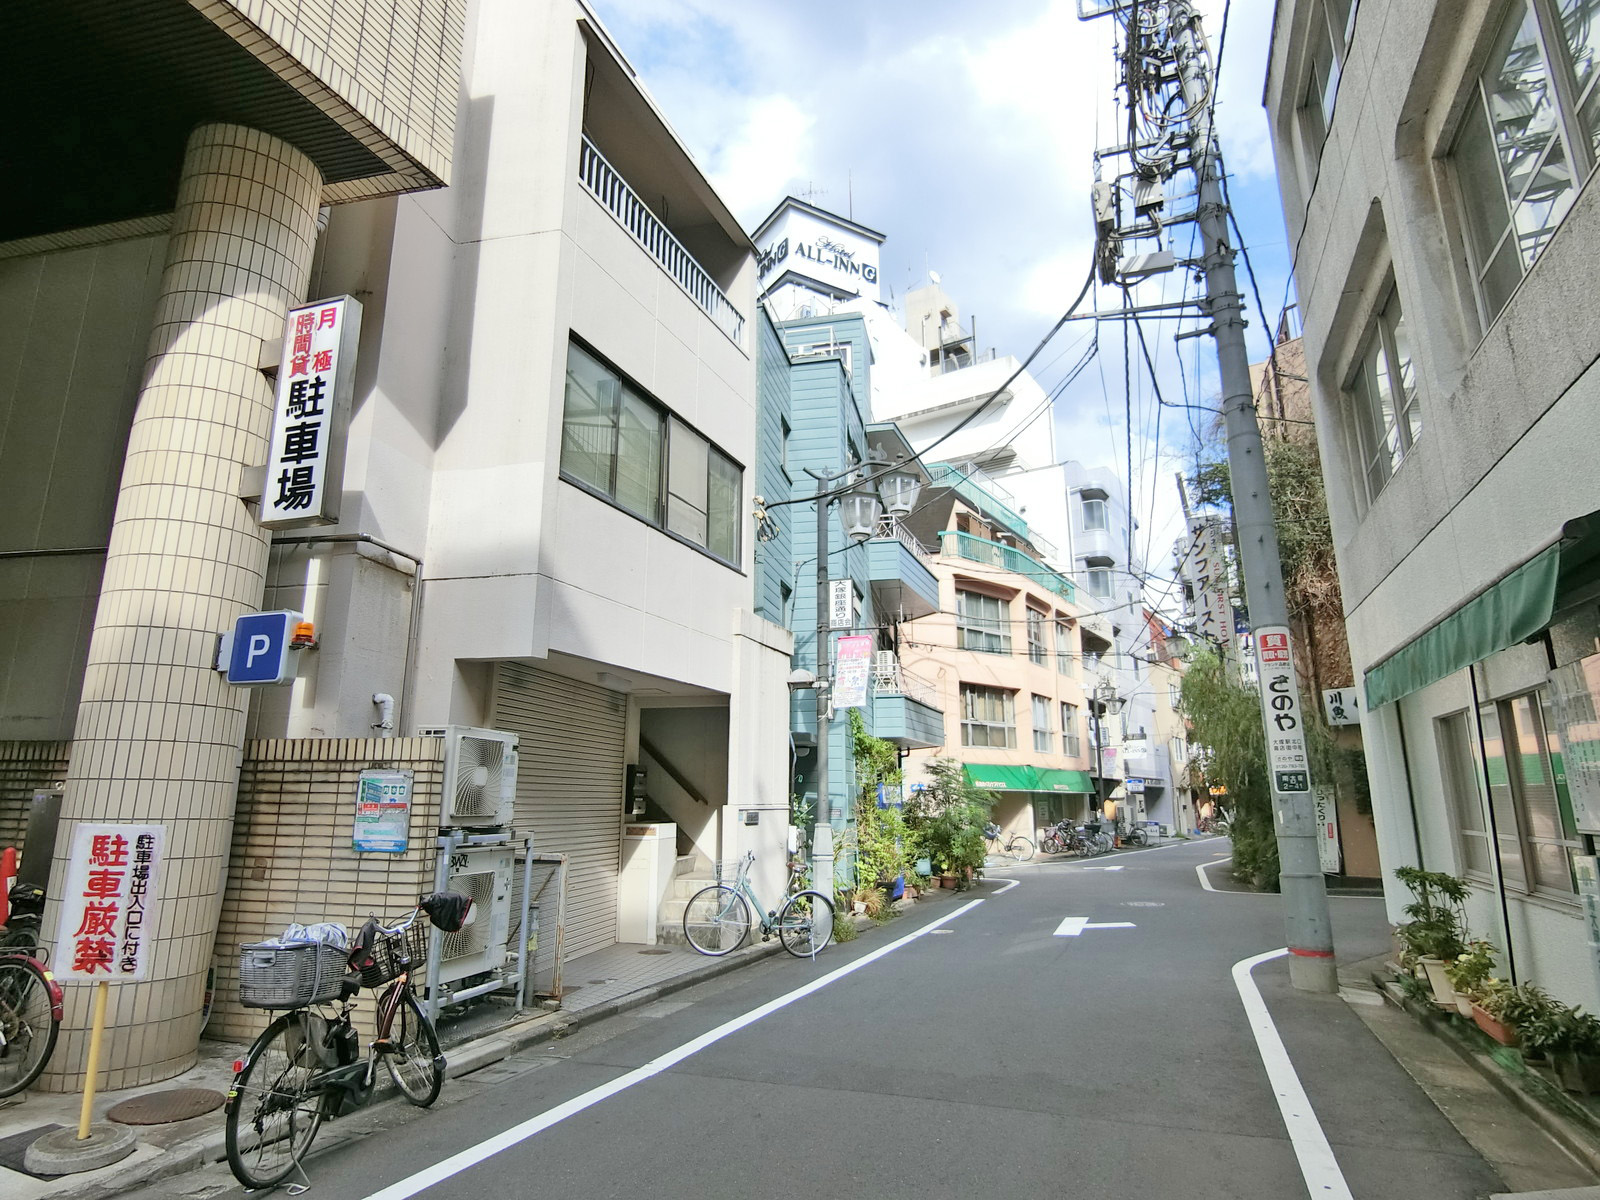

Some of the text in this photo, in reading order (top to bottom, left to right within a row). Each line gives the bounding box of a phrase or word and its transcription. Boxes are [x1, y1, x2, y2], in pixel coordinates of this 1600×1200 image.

[795, 242, 860, 275] ALL-INN
[815, 235, 856, 259] Hotel
[288, 312, 315, 378] 時間貸
[312, 307, 337, 374] 月極
[274, 375, 327, 511] 駐車場
[246, 634, 271, 669] P
[1269, 674, 1297, 732] さのや
[1329, 691, 1349, 721] 川魚
[72, 833, 129, 975] 駐車厳禁
[120, 833, 155, 973] 駐車場出入口に付き
